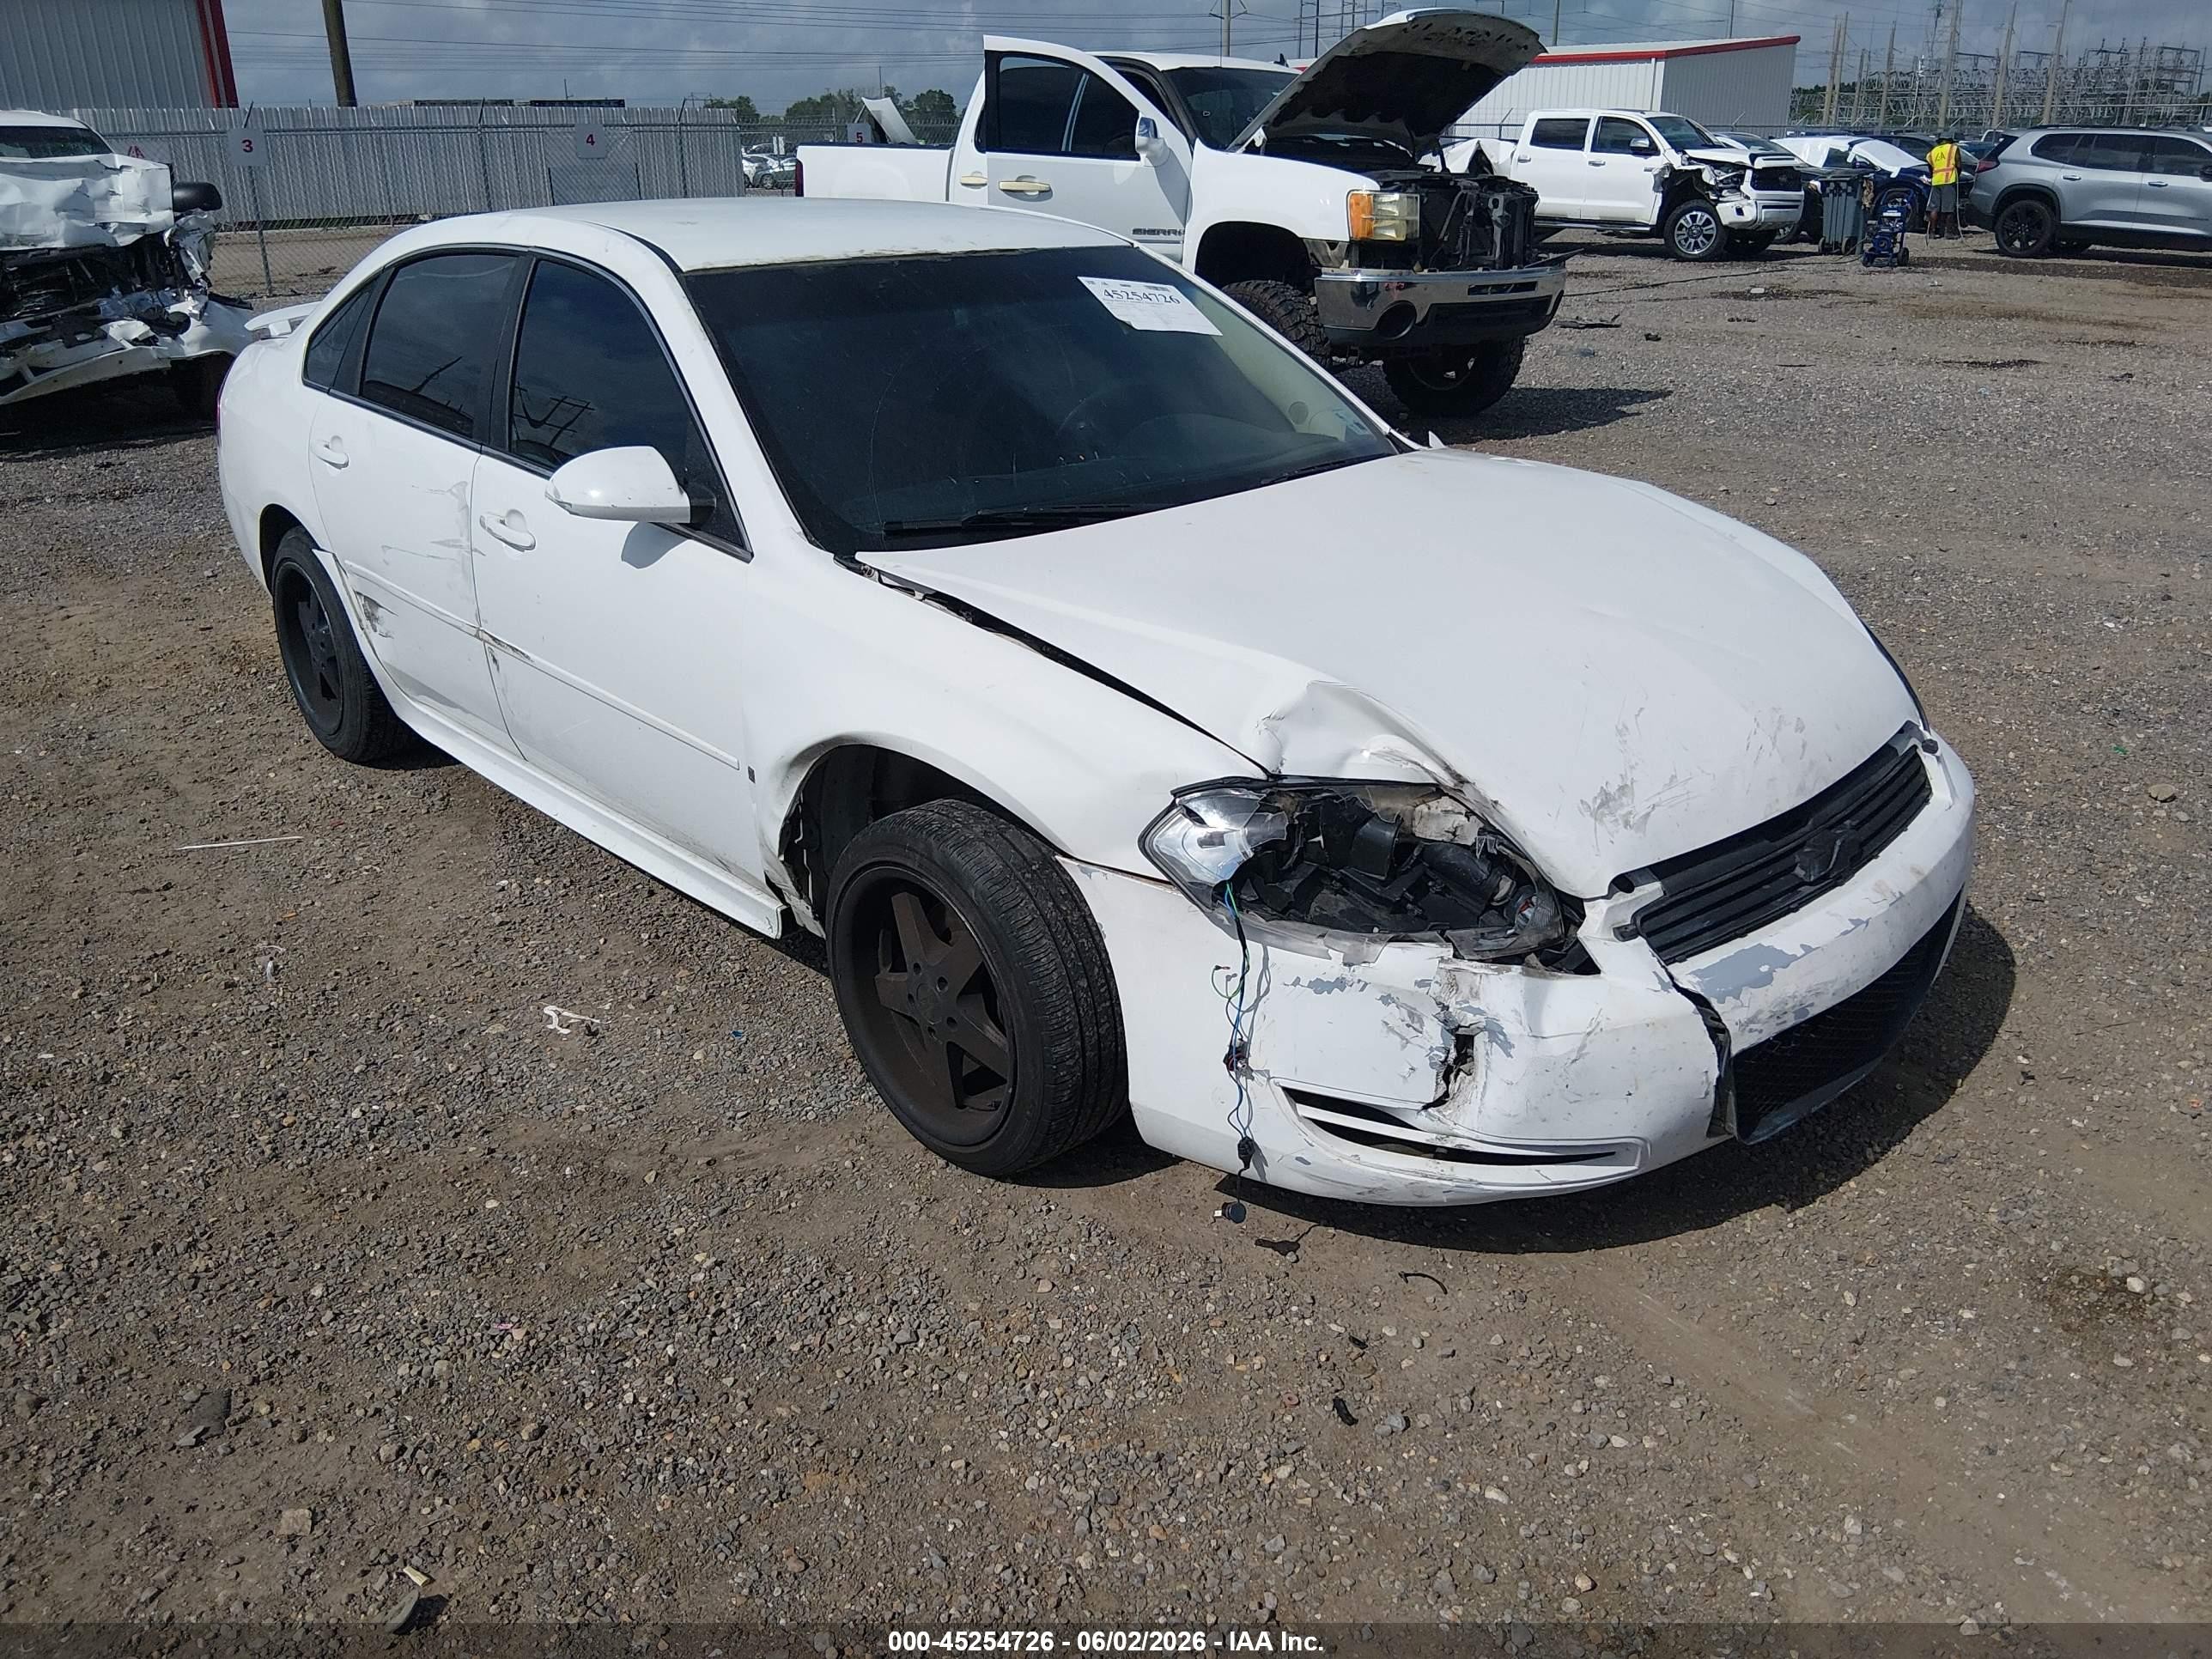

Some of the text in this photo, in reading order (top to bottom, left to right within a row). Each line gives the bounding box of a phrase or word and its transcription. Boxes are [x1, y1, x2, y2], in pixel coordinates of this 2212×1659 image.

[586, 134, 595, 146] 4
[856, 131, 863, 143] 5
[241, 139, 253, 153] 3
[1103, 289, 1181, 305] 45254726
